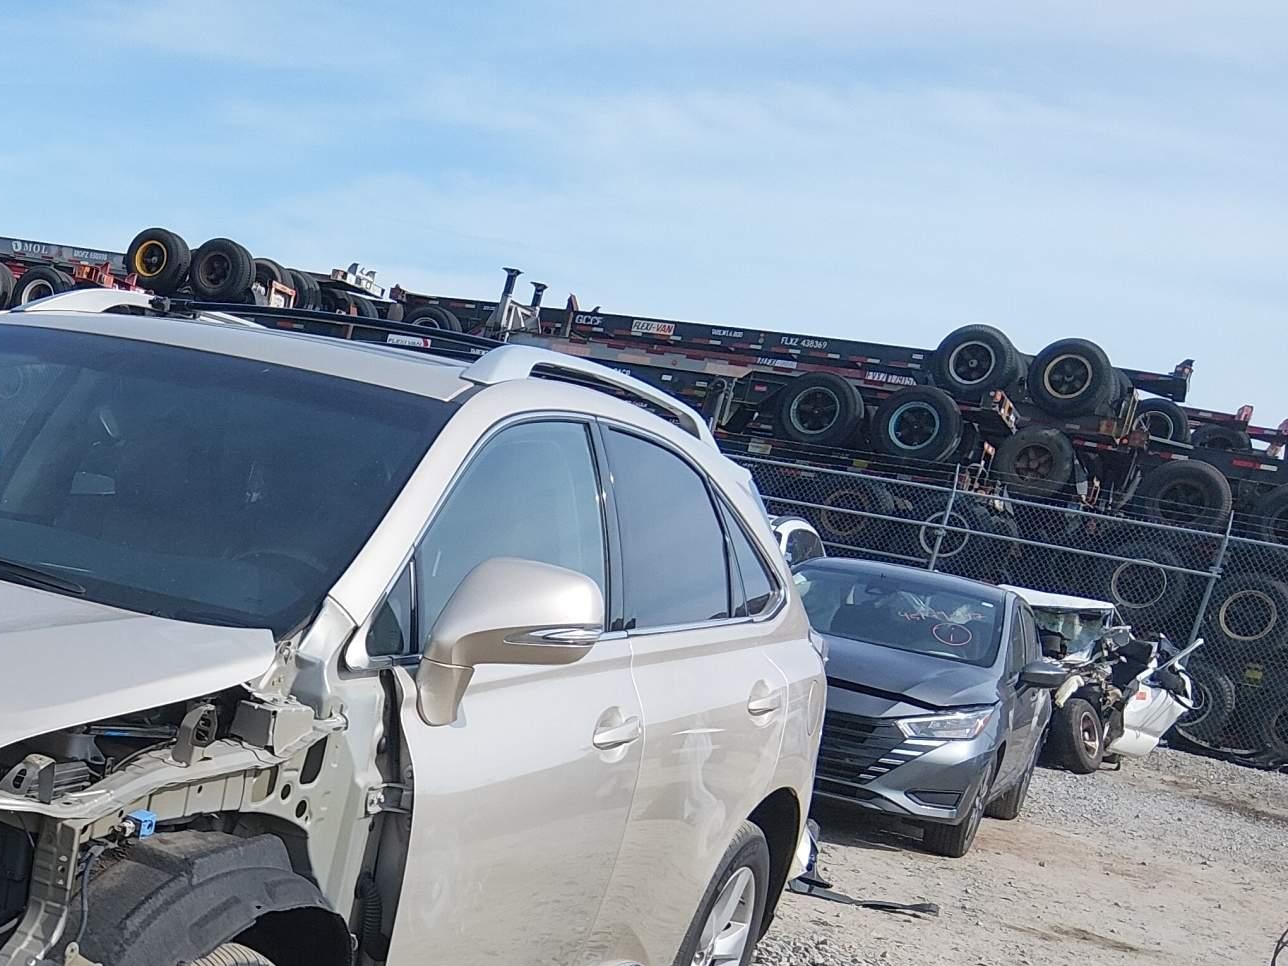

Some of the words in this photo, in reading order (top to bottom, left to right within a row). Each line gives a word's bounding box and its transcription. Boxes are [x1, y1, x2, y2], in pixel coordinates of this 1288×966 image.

[23, 241, 49, 254] MOL
[632, 321, 674, 334] FLEXI-VAN
[780, 336, 799, 346] FLXZ
[800, 340, 828, 349] 438369
